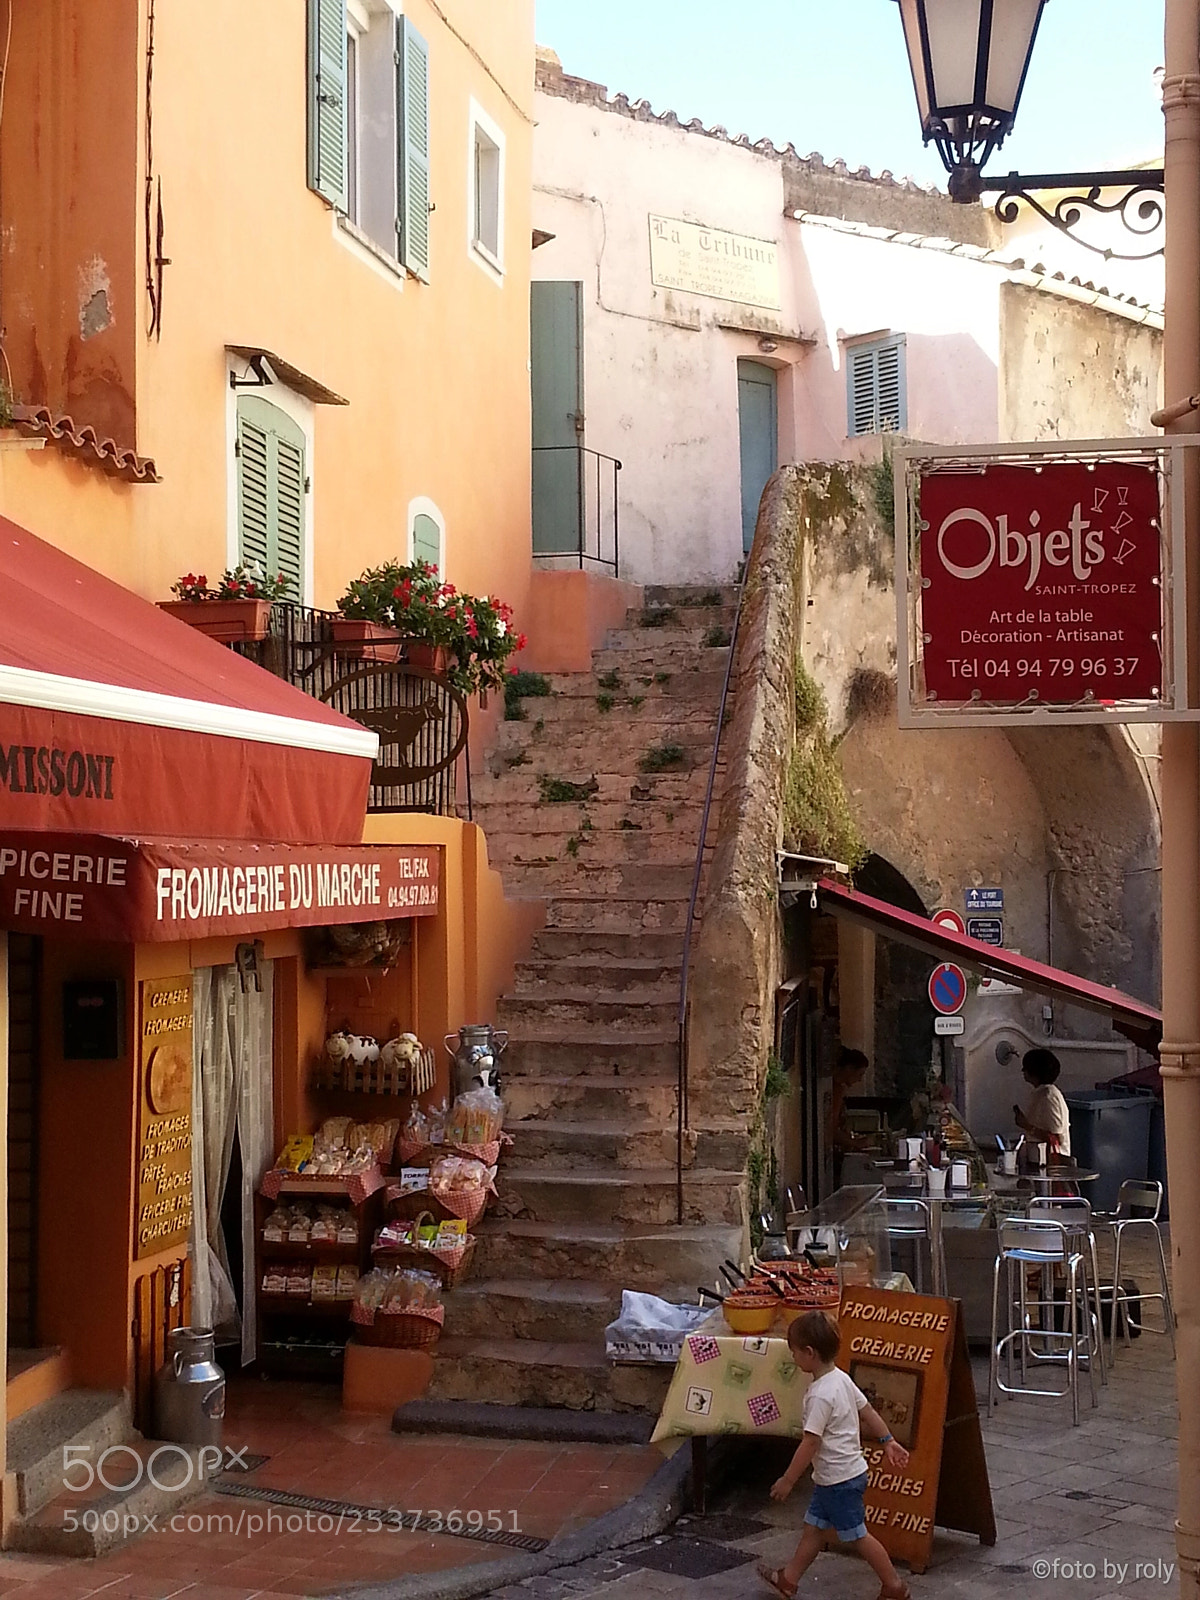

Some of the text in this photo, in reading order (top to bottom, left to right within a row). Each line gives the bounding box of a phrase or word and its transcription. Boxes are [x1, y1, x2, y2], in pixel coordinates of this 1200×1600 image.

[652, 218, 775, 264] La Tribune
[657, 273, 684, 287] SAINT
[691, 280, 724, 296] TROPEZ
[937, 502, 1106, 591] Objets
[1035, 583, 1137, 595] SAINT-TROPEZ
[989, 608, 1094, 623] Art de la table
[960, 629, 1043, 644] Décoration
[1056, 628, 1124, 642] Artisanat
[946, 657, 1139, 678] Tél 04 94 79 96 37
[0, 744, 114, 800] MISSONI
[0, 848, 127, 886] PICERIE
[14, 888, 84, 922] FINE
[157, 863, 381, 921] FROMAGERIE DU MARCHE
[146, 1014, 193, 1035] FROMAGERIE
[148, 1114, 189, 1138] FROMAGES
[144, 1144, 155, 1160] DE
[177, 1191, 193, 1210] FINE
[141, 1211, 193, 1243] CHARCUTERIE
[842, 1301, 949, 1331] FROMAGERIE
[865, 1505, 931, 1534] RIE FINE
